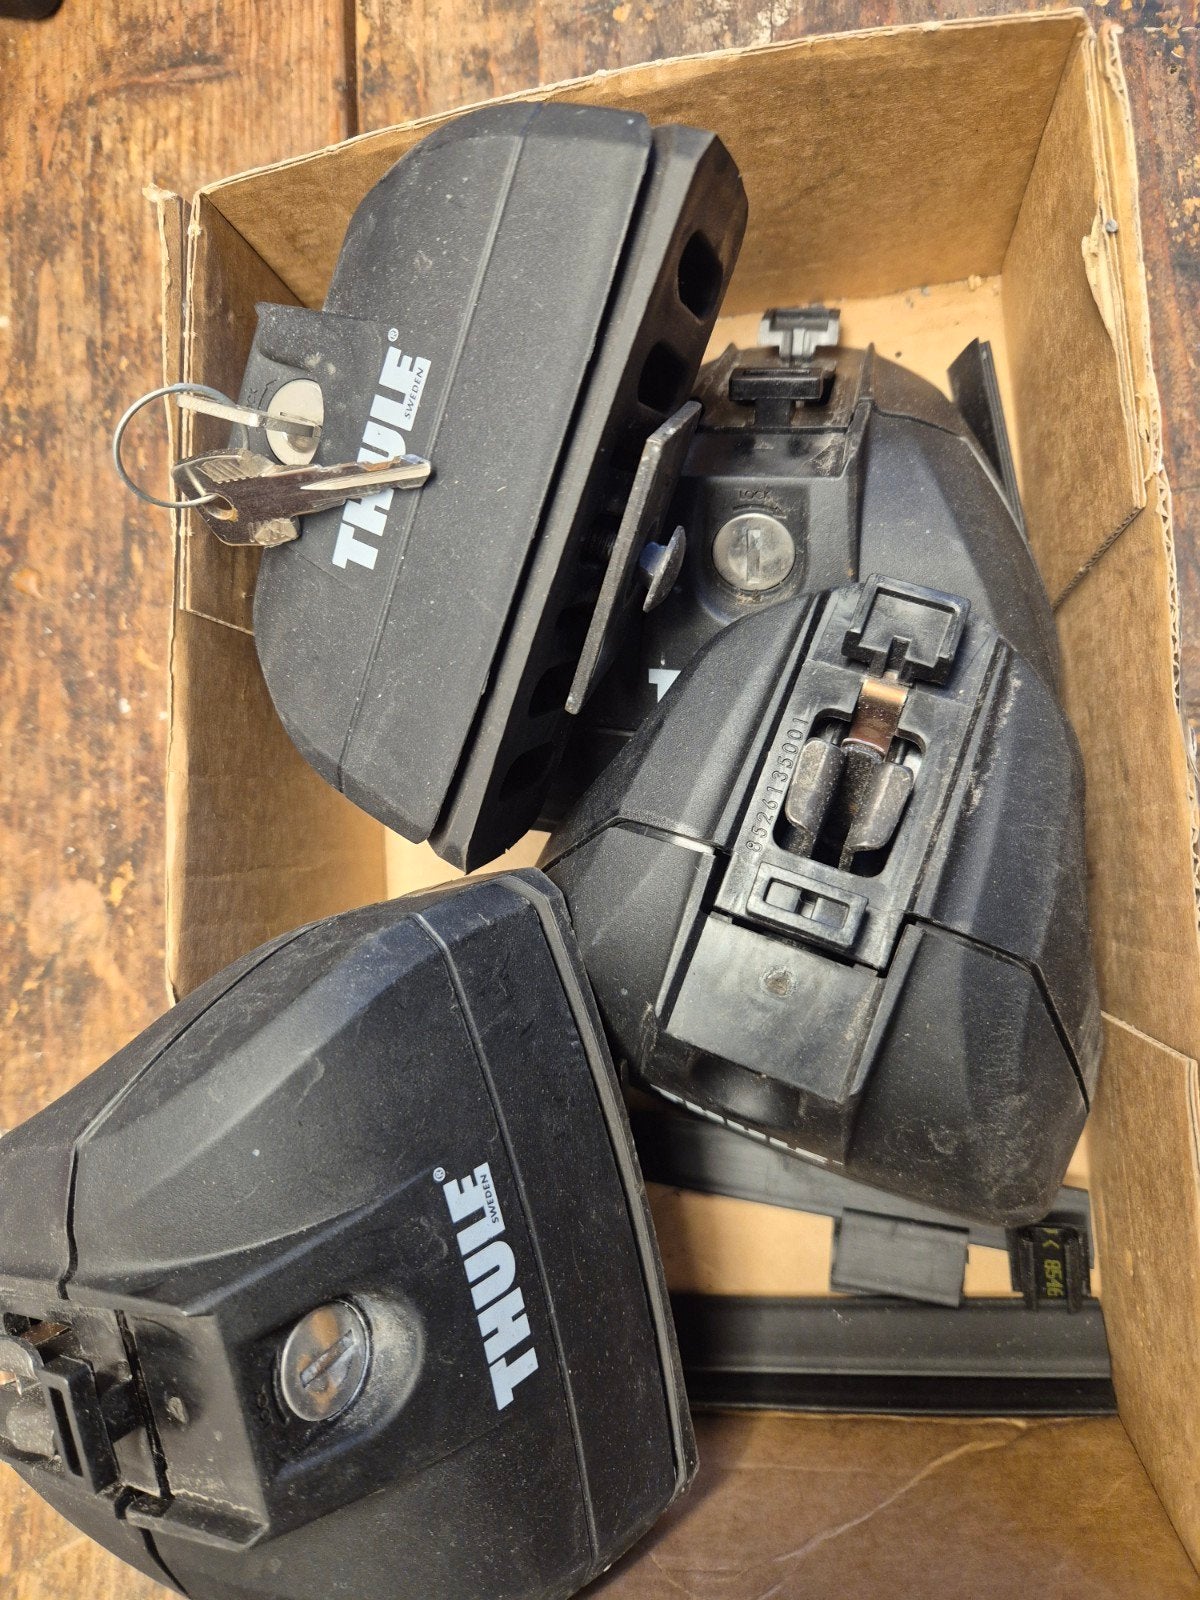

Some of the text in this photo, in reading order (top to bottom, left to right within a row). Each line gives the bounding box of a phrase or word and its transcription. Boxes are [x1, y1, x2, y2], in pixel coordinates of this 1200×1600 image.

[404, 367, 424, 419] SWEDEN
[739, 489, 770, 501] LOCK
[745, 716, 809, 853] 8526135001
[480, 1173, 500, 1224] SWEDEN
